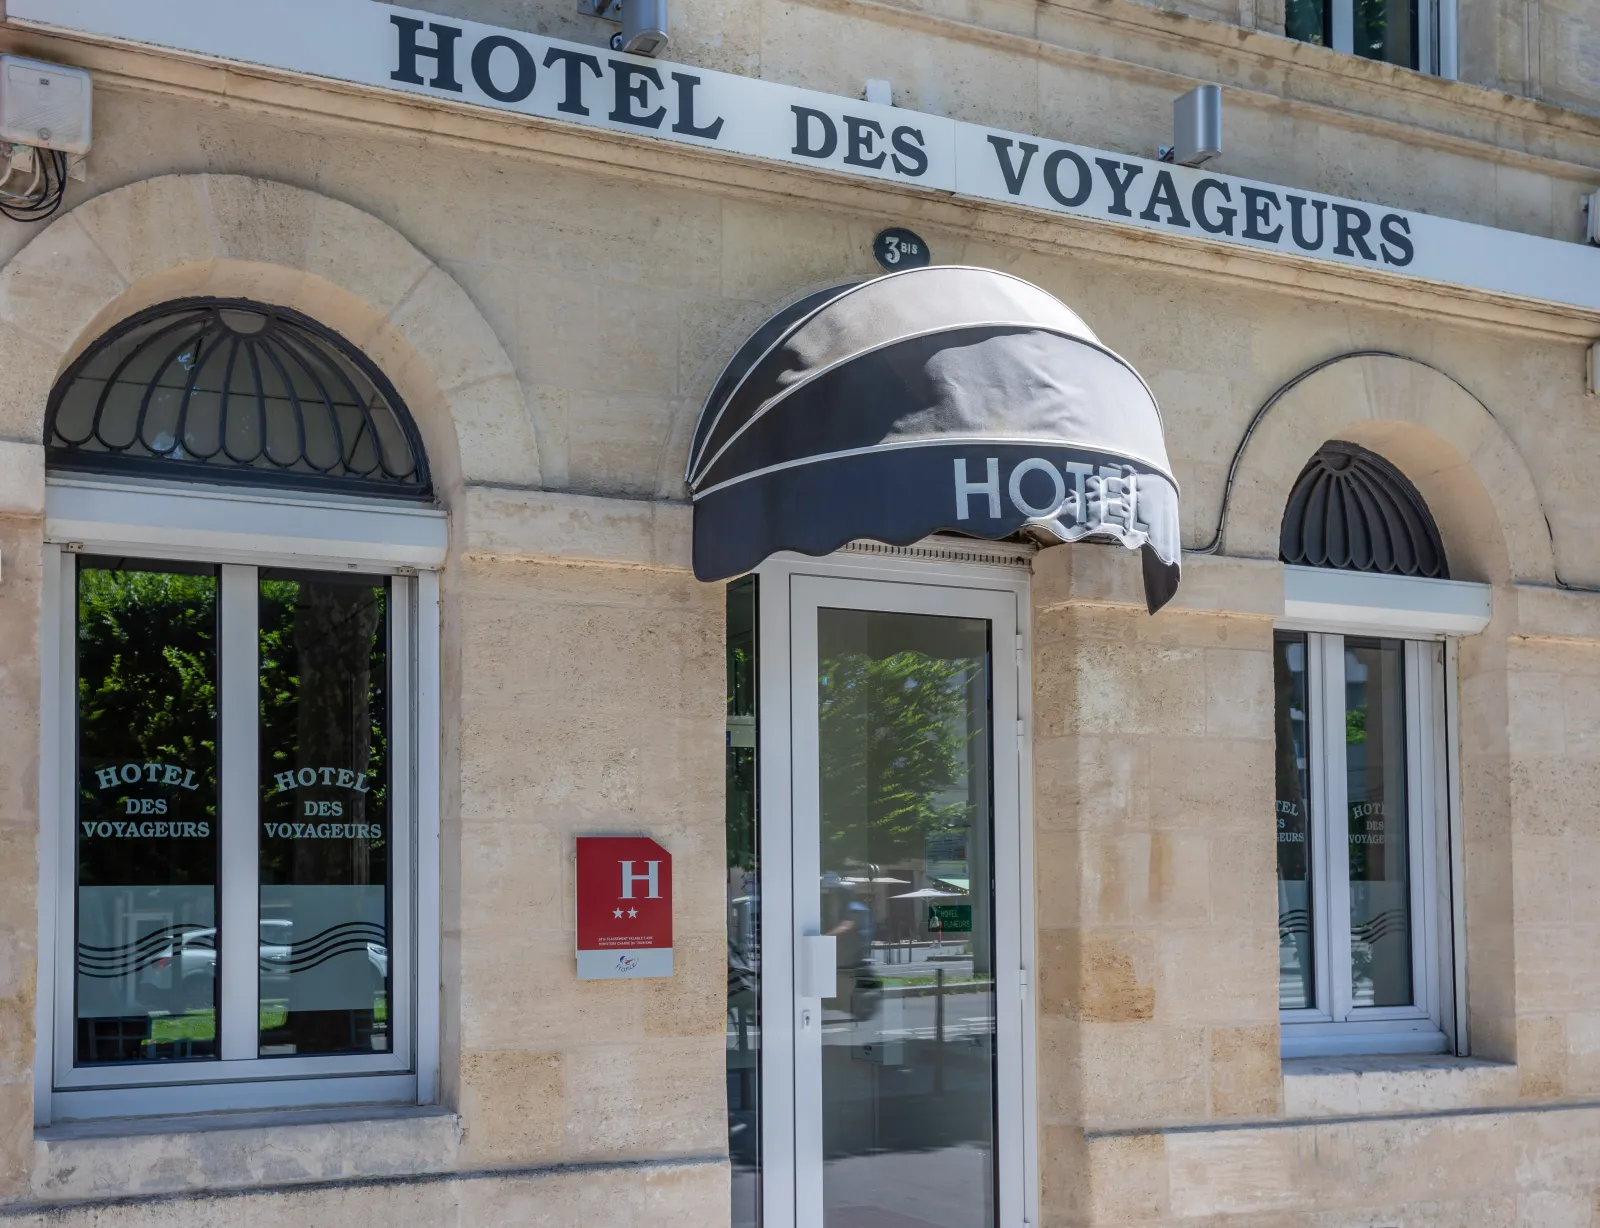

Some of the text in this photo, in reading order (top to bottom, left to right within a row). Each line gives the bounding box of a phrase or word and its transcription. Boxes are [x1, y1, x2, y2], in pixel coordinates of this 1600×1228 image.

[389, 15, 1414, 267] HOTEL DES VOYAGEURS
[953, 457, 1149, 533] HOTEL
[95, 763, 200, 791] HOTEL
[274, 766, 370, 793] HOTEL
[125, 798, 168, 815] DES
[303, 801, 343, 817] DES
[81, 821, 210, 839] VOYAGEURS
[263, 822, 382, 840] VOYAGEURS
[617, 860, 663, 899] H
